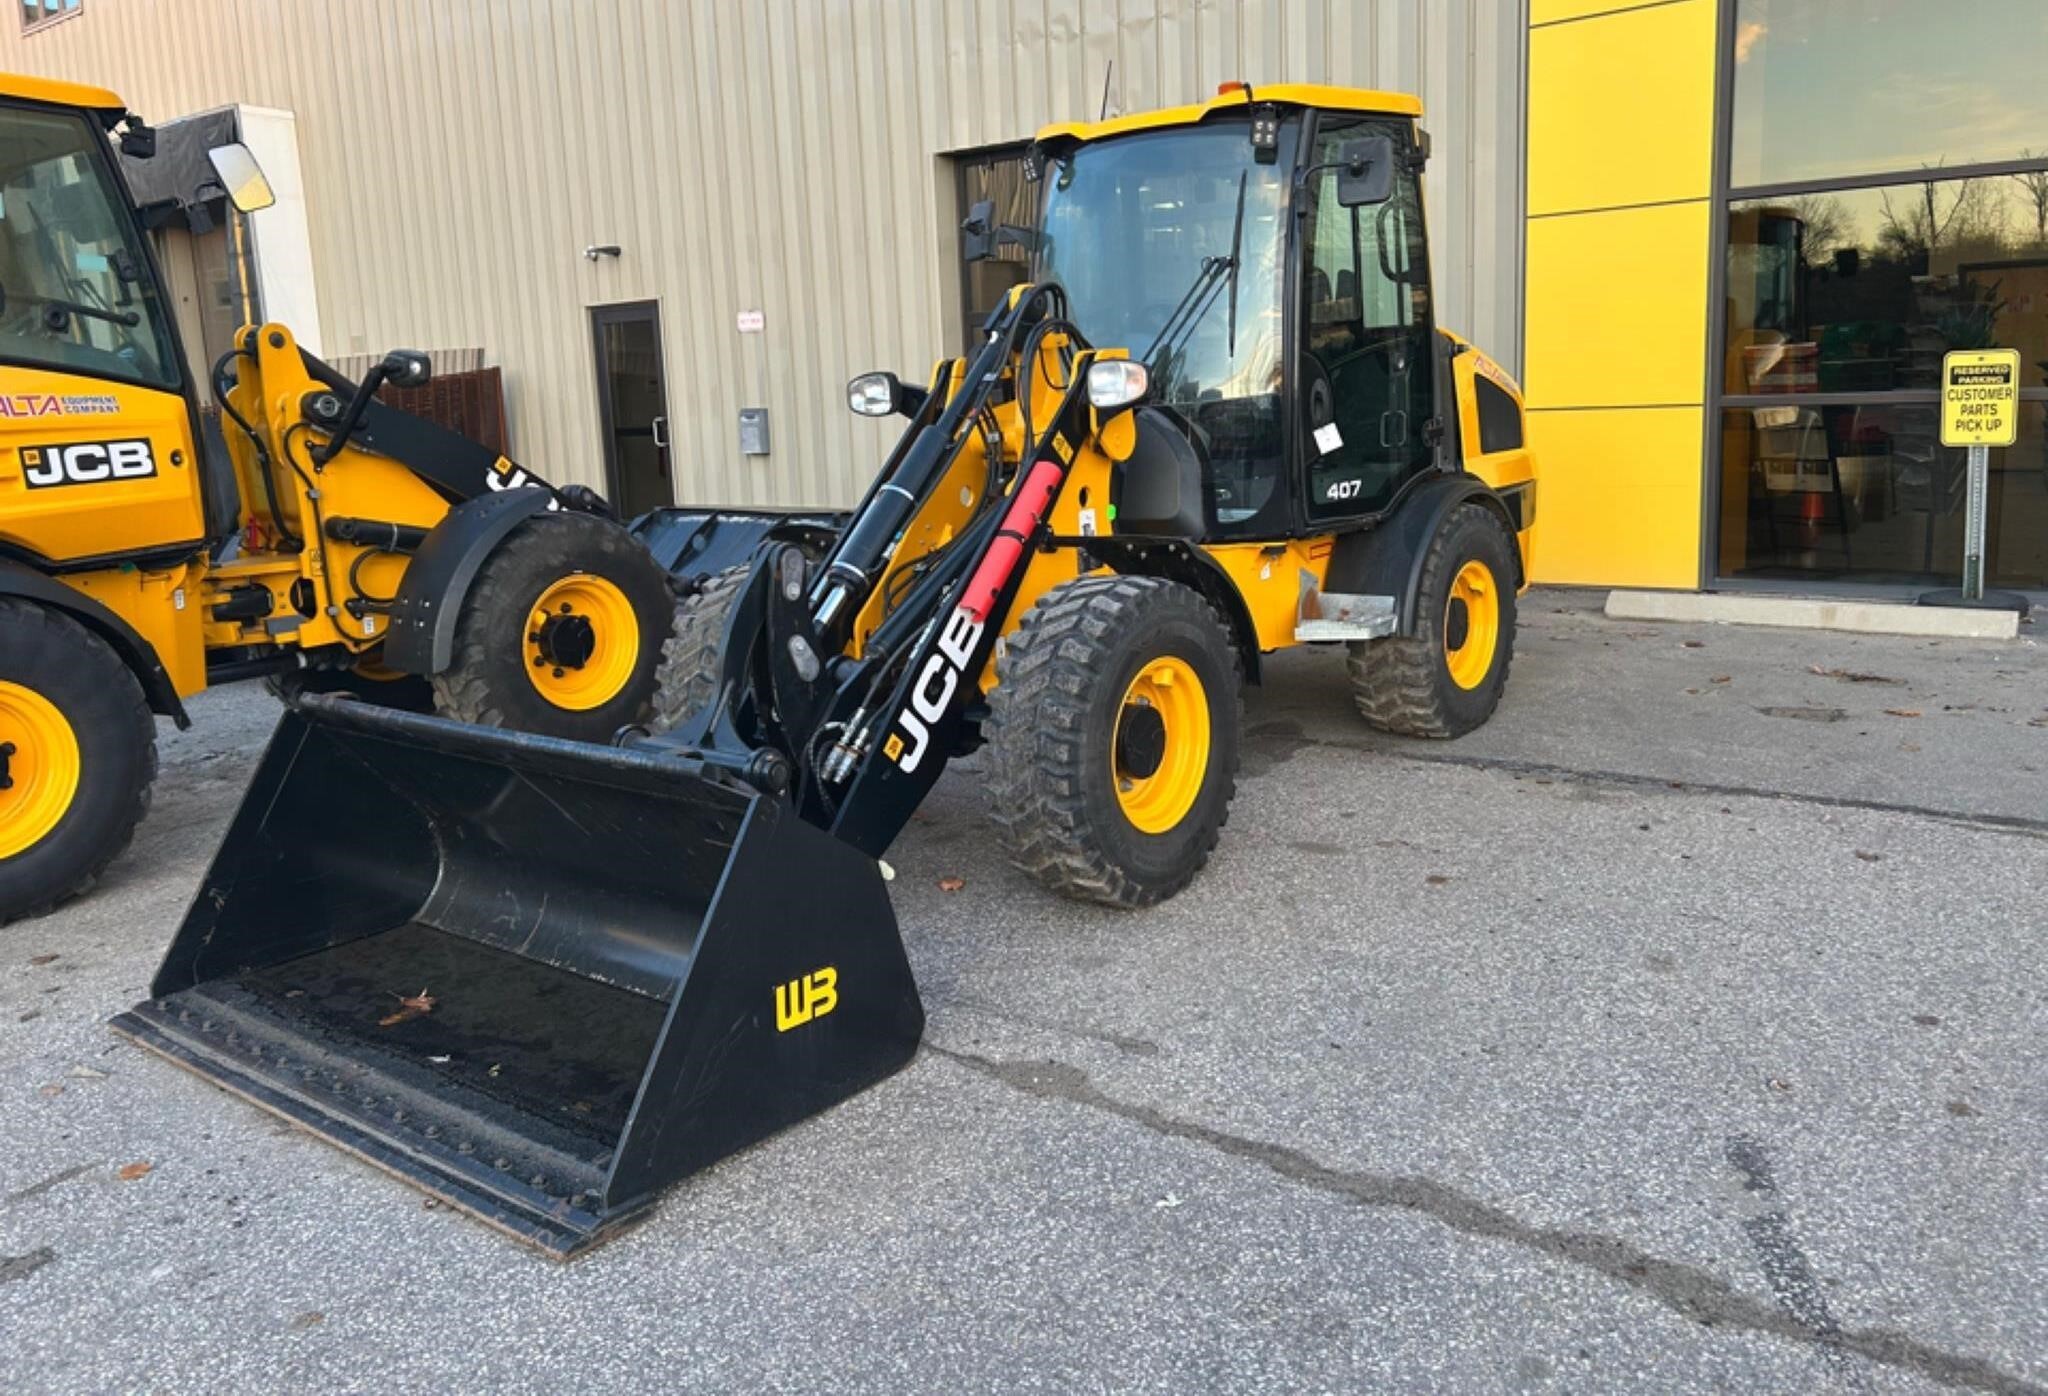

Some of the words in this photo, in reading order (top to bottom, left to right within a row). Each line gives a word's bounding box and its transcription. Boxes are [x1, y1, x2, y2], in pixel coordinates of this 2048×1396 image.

[1953, 365, 2009, 375] RESERVED
[1958, 375, 2004, 384] PARKING
[1947, 387, 2013, 401] CUSTOMER
[63, 405, 121, 414] COMPANY
[1960, 404, 1998, 416] PARTS
[1955, 419, 1983, 432] PICK
[1986, 418, 2002, 431] UP
[26, 441, 154, 485] JCB
[1326, 479, 1362, 500] 407
[776, 966, 837, 1032] WB
